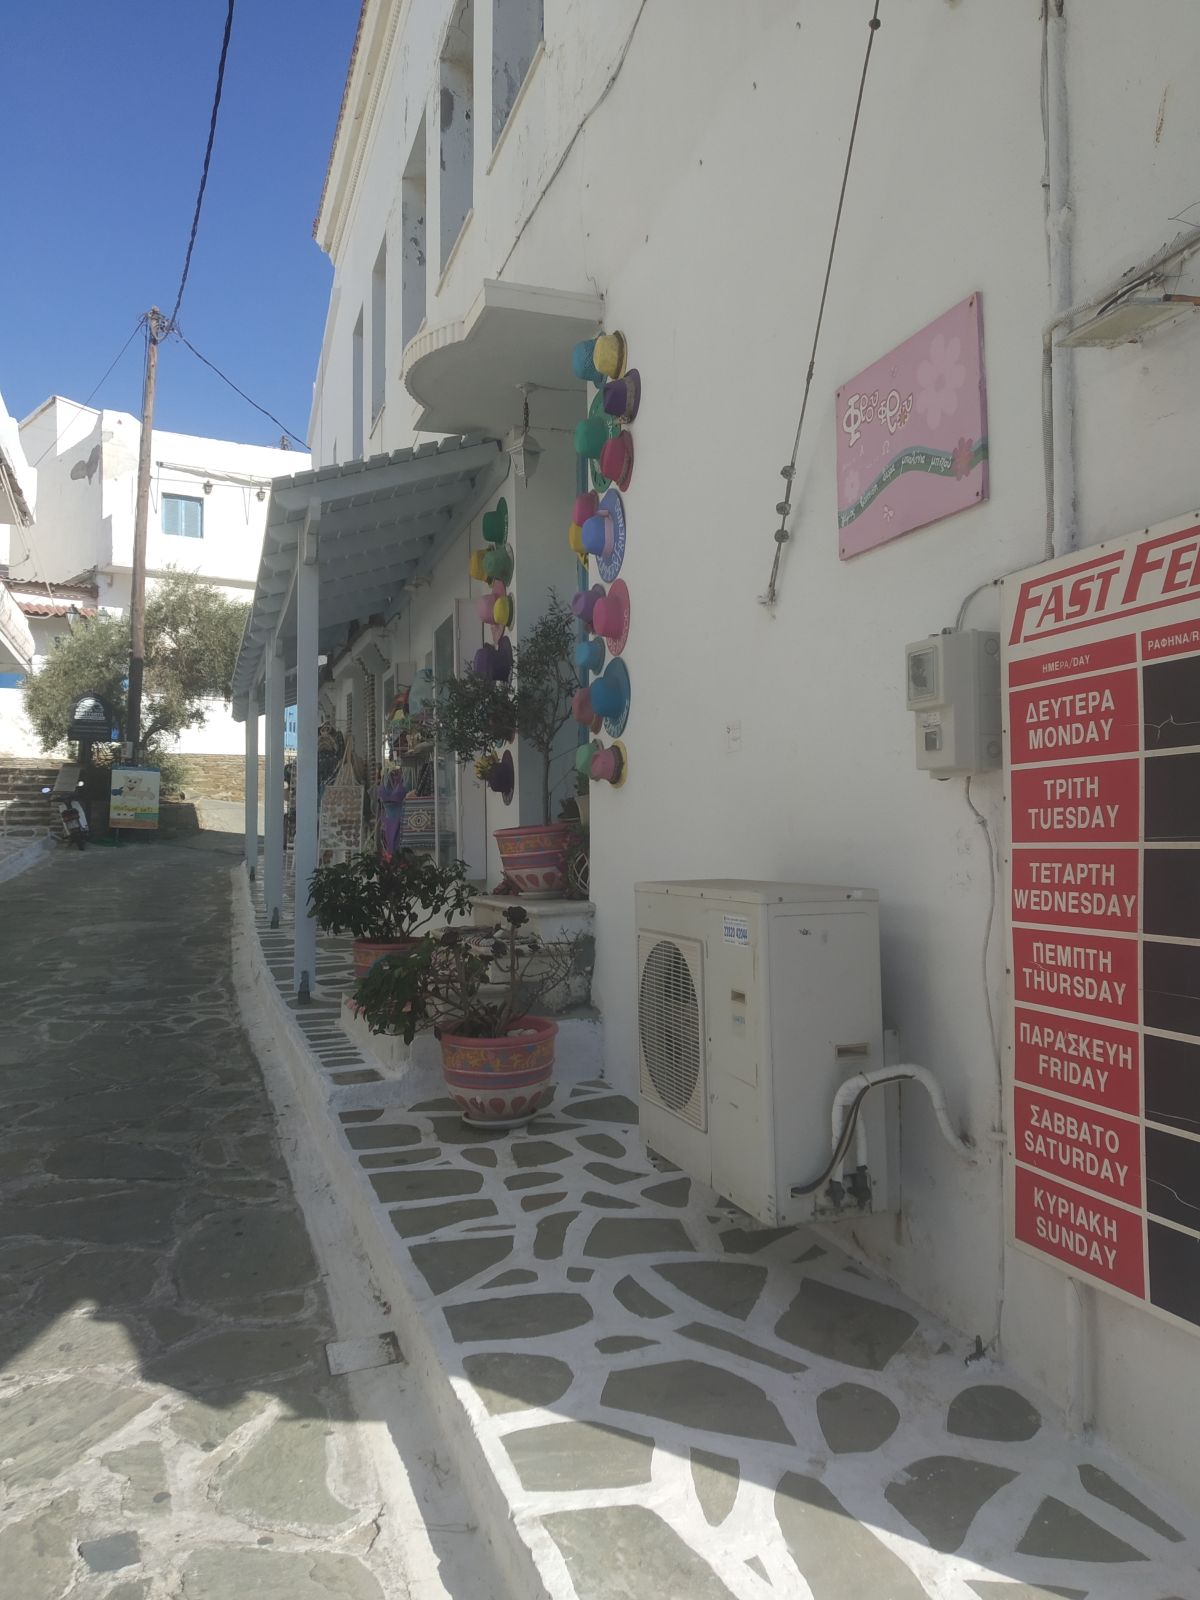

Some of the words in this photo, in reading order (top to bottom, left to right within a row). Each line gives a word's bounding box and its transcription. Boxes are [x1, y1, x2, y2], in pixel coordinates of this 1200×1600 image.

[1008, 550, 1126, 646] FAST
[1121, 523, 1200, 606] FE
[1042, 654, 1091, 673] ΗΜΕΡΑ/DAY
[1025, 688, 1115, 724] ΔΕΥΤΕΡΑ
[1028, 718, 1114, 750] MONDAY
[1043, 775, 1099, 801] ΤΡΙΤΗ
[1028, 804, 1120, 830] TUESDAY
[1029, 862, 1115, 886] ΤΕΤΑΡΤΗ
[1014, 888, 1136, 918] WEDNESDAY
[1032, 941, 1113, 974] ΠΕΜΠΤΗ
[1022, 967, 1127, 1006] THURSDAY
[1019, 1022, 1133, 1070] ΠΑΡΑΣΚΕΥΗ
[1038, 1054, 1109, 1093] FRIDAY
[1030, 1104, 1120, 1154] ΣΑΒΒΑΤΟ
[1023, 1130, 1129, 1187] SATURDAY
[1033, 1186, 1118, 1243] ΚΥΡΙΑΚΗ
[1036, 1215, 1117, 1271] SUNDAY
